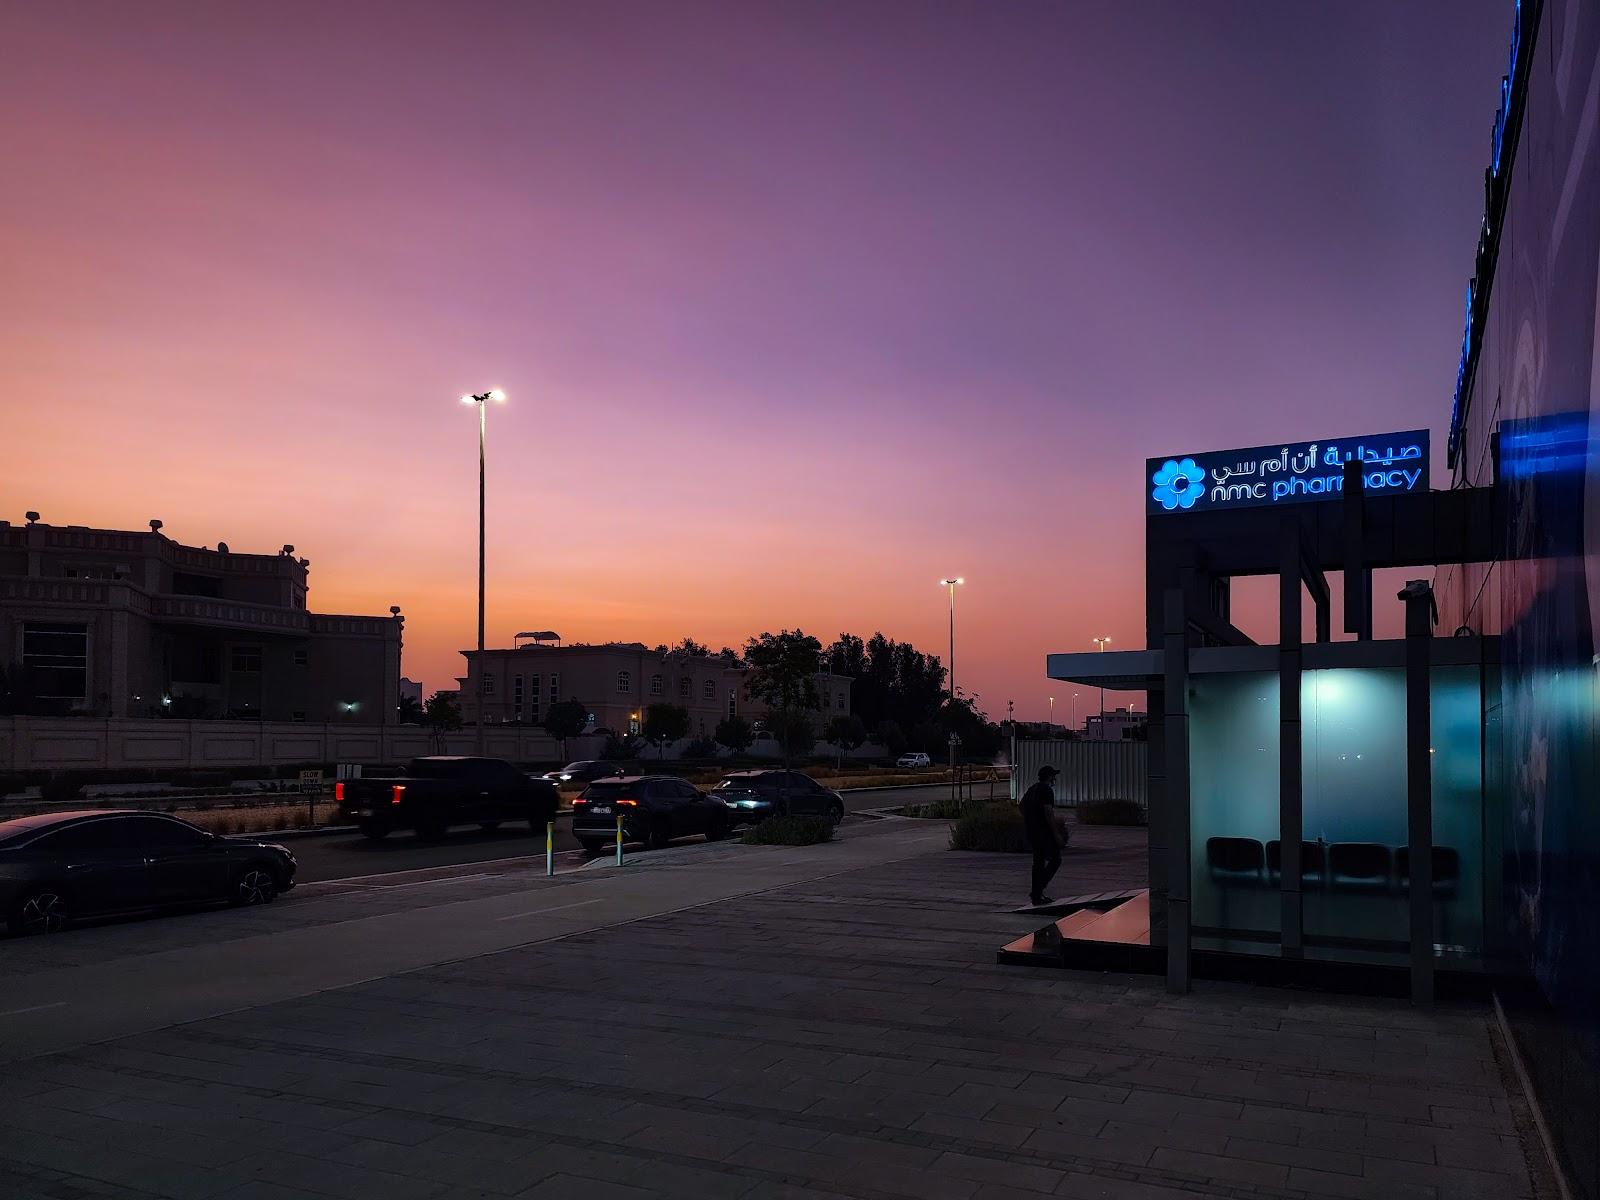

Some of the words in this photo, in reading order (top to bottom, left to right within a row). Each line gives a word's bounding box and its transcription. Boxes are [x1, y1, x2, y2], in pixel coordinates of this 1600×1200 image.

[1260, 447, 1289, 476] أم
[1292, 444, 1318, 474] أن
[1211, 461, 1256, 485] سي
[1211, 482, 1267, 502] nmc
